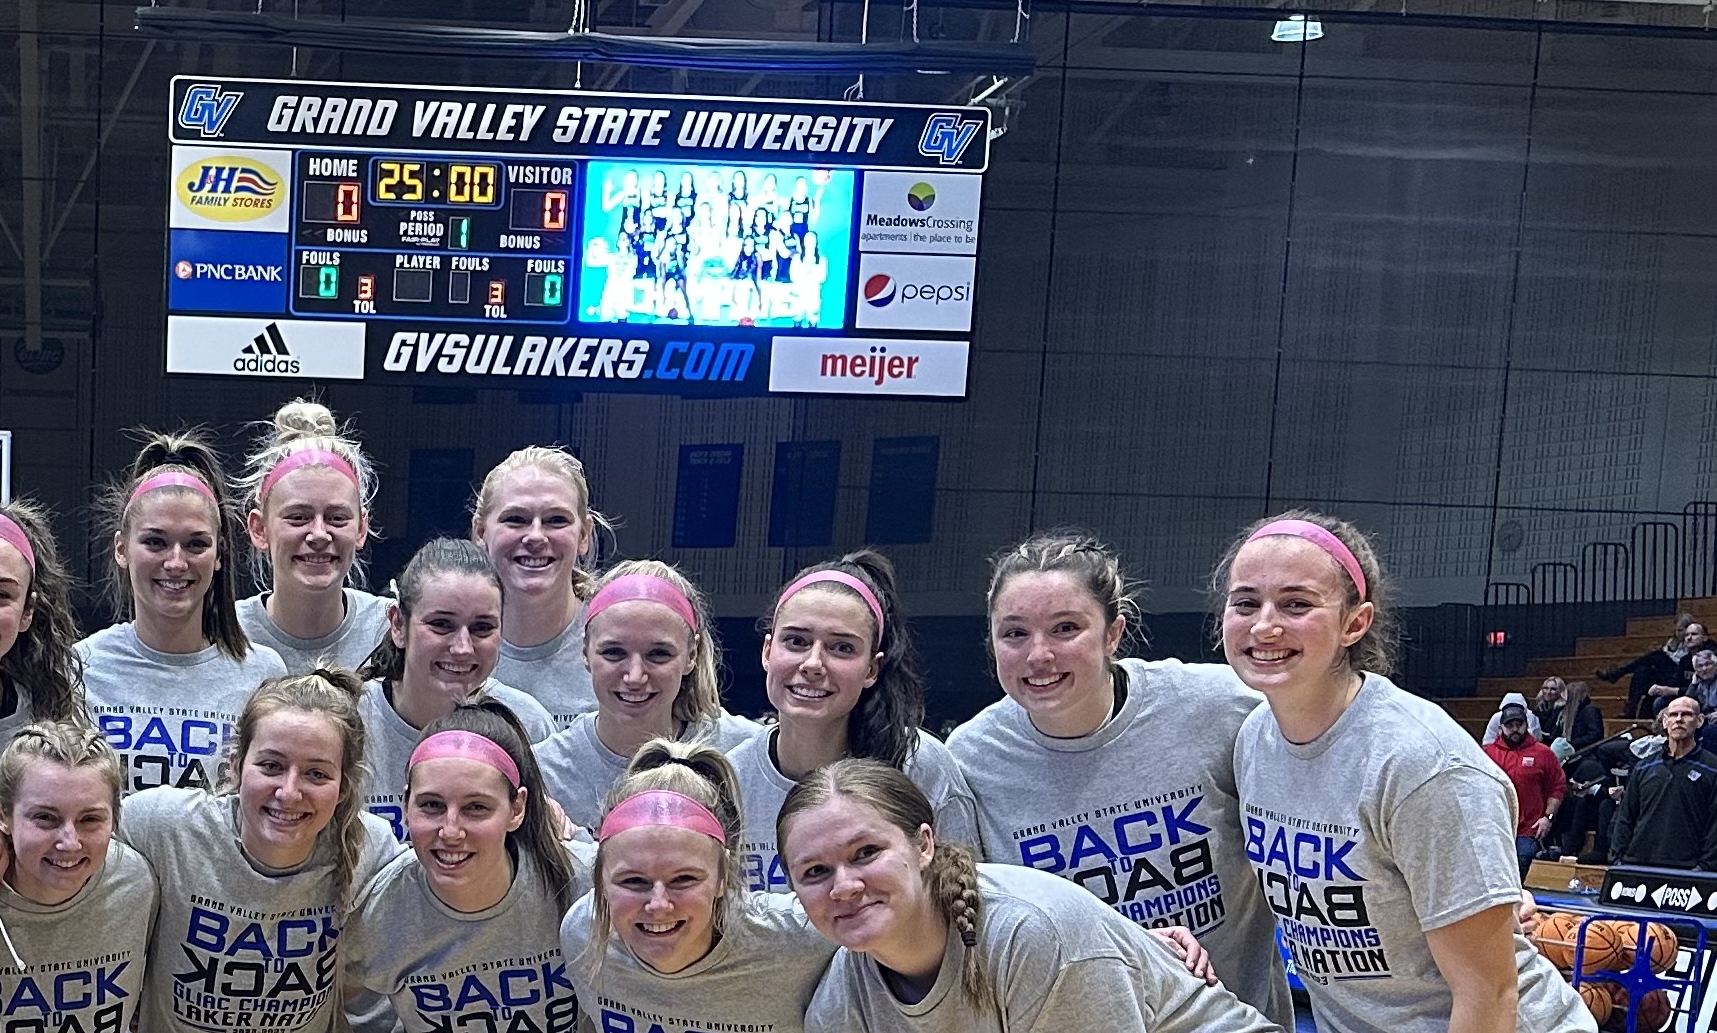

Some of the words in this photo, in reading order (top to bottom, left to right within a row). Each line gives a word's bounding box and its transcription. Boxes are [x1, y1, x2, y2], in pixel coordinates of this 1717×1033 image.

[179, 84, 244, 137] GV
[267, 95, 399, 136] GRAND
[412, 100, 547, 142] VALLEY
[552, 105, 671, 147] STATE
[677, 110, 894, 154] UNIVERSITY
[918, 112, 983, 165] GV
[309, 157, 358, 177] HOME
[508, 165, 573, 185] VISITOR
[378, 161, 495, 204] 25:00
[190, 196, 229, 206] FAMILY
[232, 197, 273, 208] STORES
[410, 210, 434, 221] POSS
[326, 228, 368, 243] BONUS
[399, 222, 444, 236] PERIOD
[461, 219, 468, 248] 1
[913, 233, 926, 242] the
[929, 233, 951, 243] place
[966, 235, 975, 243] be
[499, 235, 540, 249] BONUS
[302, 251, 340, 265] FOULS
[395, 255, 441, 269] PLAYER
[451, 257, 489, 271] FOULS
[527, 260, 565, 273] FOULS
[359, 277, 373, 299] 3
[489, 282, 503, 304] 3
[901, 282, 970, 305] pepsi
[353, 300, 376, 314] TOL
[484, 305, 507, 319] TOL
[234, 355, 300, 374] adidas
[384, 331, 755, 382] GVSULAKERS.COM
[821, 346, 919, 385] meijer
[169, 708, 199, 718] STATE
[167, 750, 187, 768] TO
[1013, 824, 1046, 840] GRAND
[1052, 812, 1089, 829] VALLEY
[1095, 804, 1129, 819] STATE
[1134, 784, 1203, 810] UNIVERSITY
[1019, 795, 1212, 873] BACK
[1288, 817, 1310, 830] STATE
[1246, 816, 1370, 881] BACK
[1107, 856, 1132, 875] TO
[190, 894, 224, 911] GRAND
[230, 905, 266, 921] VALLEY
[1662, 888, 1691, 907] POSS
[187, 907, 341, 958] BACK
[1283, 918, 1381, 948] CHAMPIONS
[41, 962, 72, 972] STATE
[77, 950, 131, 968] UNIVERSITY
[263, 957, 284, 973] TO
[1300, 944, 1391, 973] NATION
[173, 979, 230, 1011] GLIAC
[409, 962, 574, 1012] BACK
[42, 1011, 62, 1028] TO
[173, 996, 251, 1026] LAKER
[490, 1005, 512, 1021] TO
[597, 997, 627, 1012] GRAND
[631, 1007, 664, 1022] VALLEY
[669, 1018, 701, 1028] STATE
[707, 1022, 774, 1032] UNIVERSITY
